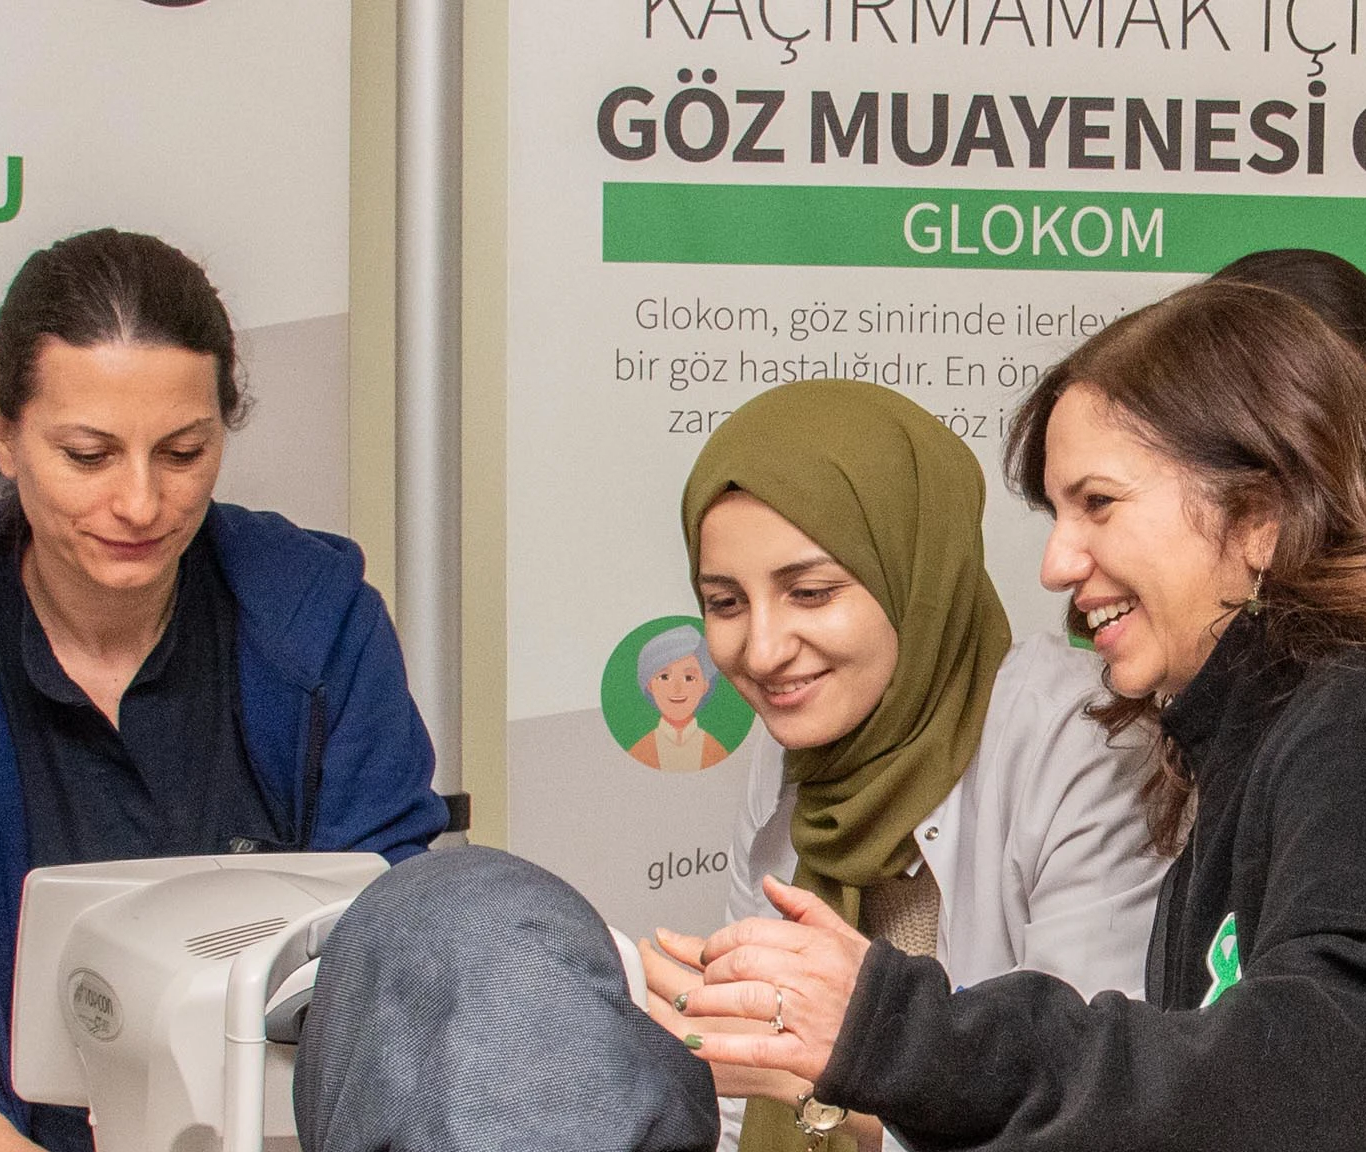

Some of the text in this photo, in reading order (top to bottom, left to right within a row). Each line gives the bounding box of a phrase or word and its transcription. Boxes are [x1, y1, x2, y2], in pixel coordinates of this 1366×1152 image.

[597, 69, 785, 164] GÖZ
[811, 80, 1327, 175] MUAYENESİ
[903, 202, 1163, 258] GLOKOM
[636, 298, 778, 336] Glokom,
[791, 303, 847, 341] göz
[858, 303, 1004, 335] sinirinde
[616, 349, 660, 381] bir
[670, 352, 728, 391] göz
[740, 351, 932, 386] hastalığıdır.
[946, 356, 985, 386] En
